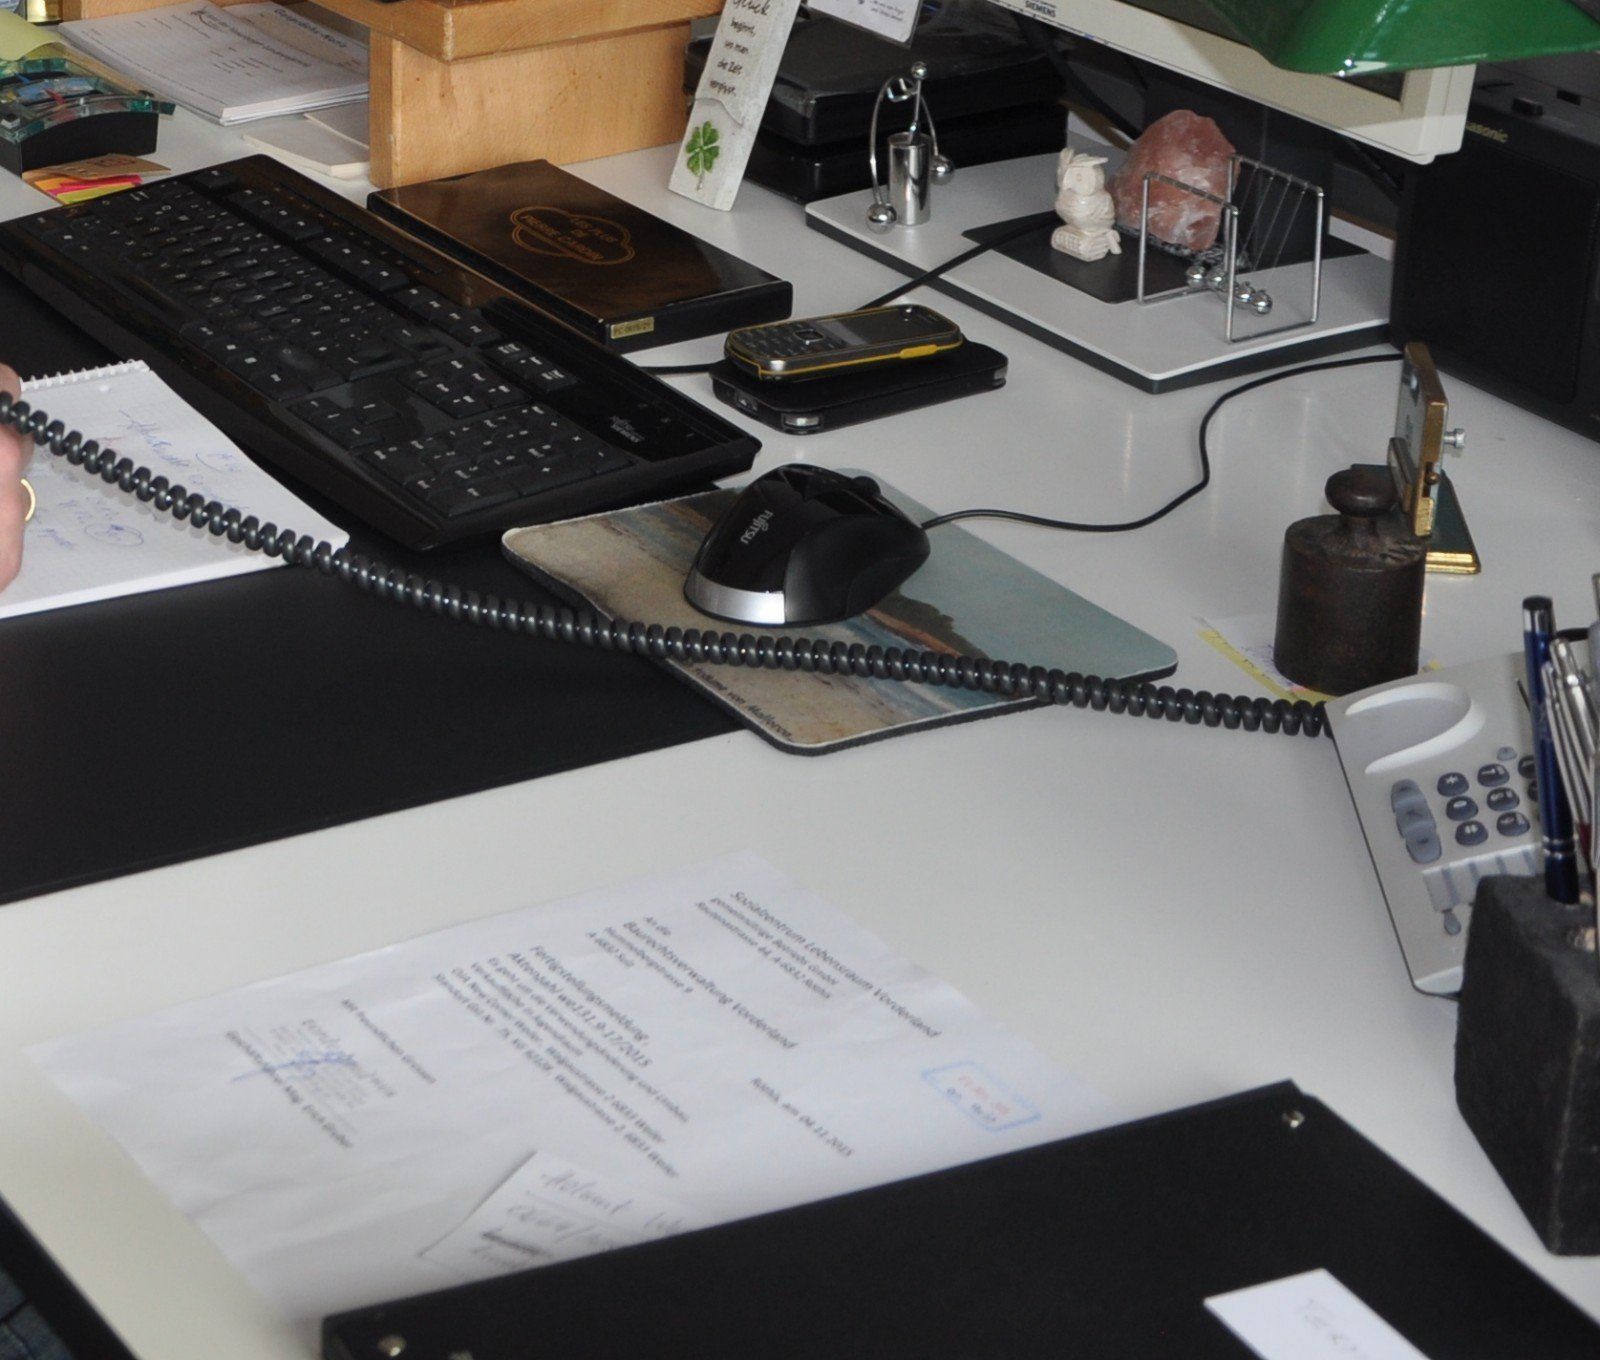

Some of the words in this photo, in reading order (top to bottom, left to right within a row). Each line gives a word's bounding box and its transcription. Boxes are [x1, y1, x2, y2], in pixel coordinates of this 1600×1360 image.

[520, 214, 562, 237] PIERRE
[556, 235, 606, 261] CARDIN
[739, 508, 774, 545] FUJITSU
[727, 691, 747, 705] von
[731, 1001, 800, 1049] Vorderland
[872, 988, 943, 1038] Vorderland
